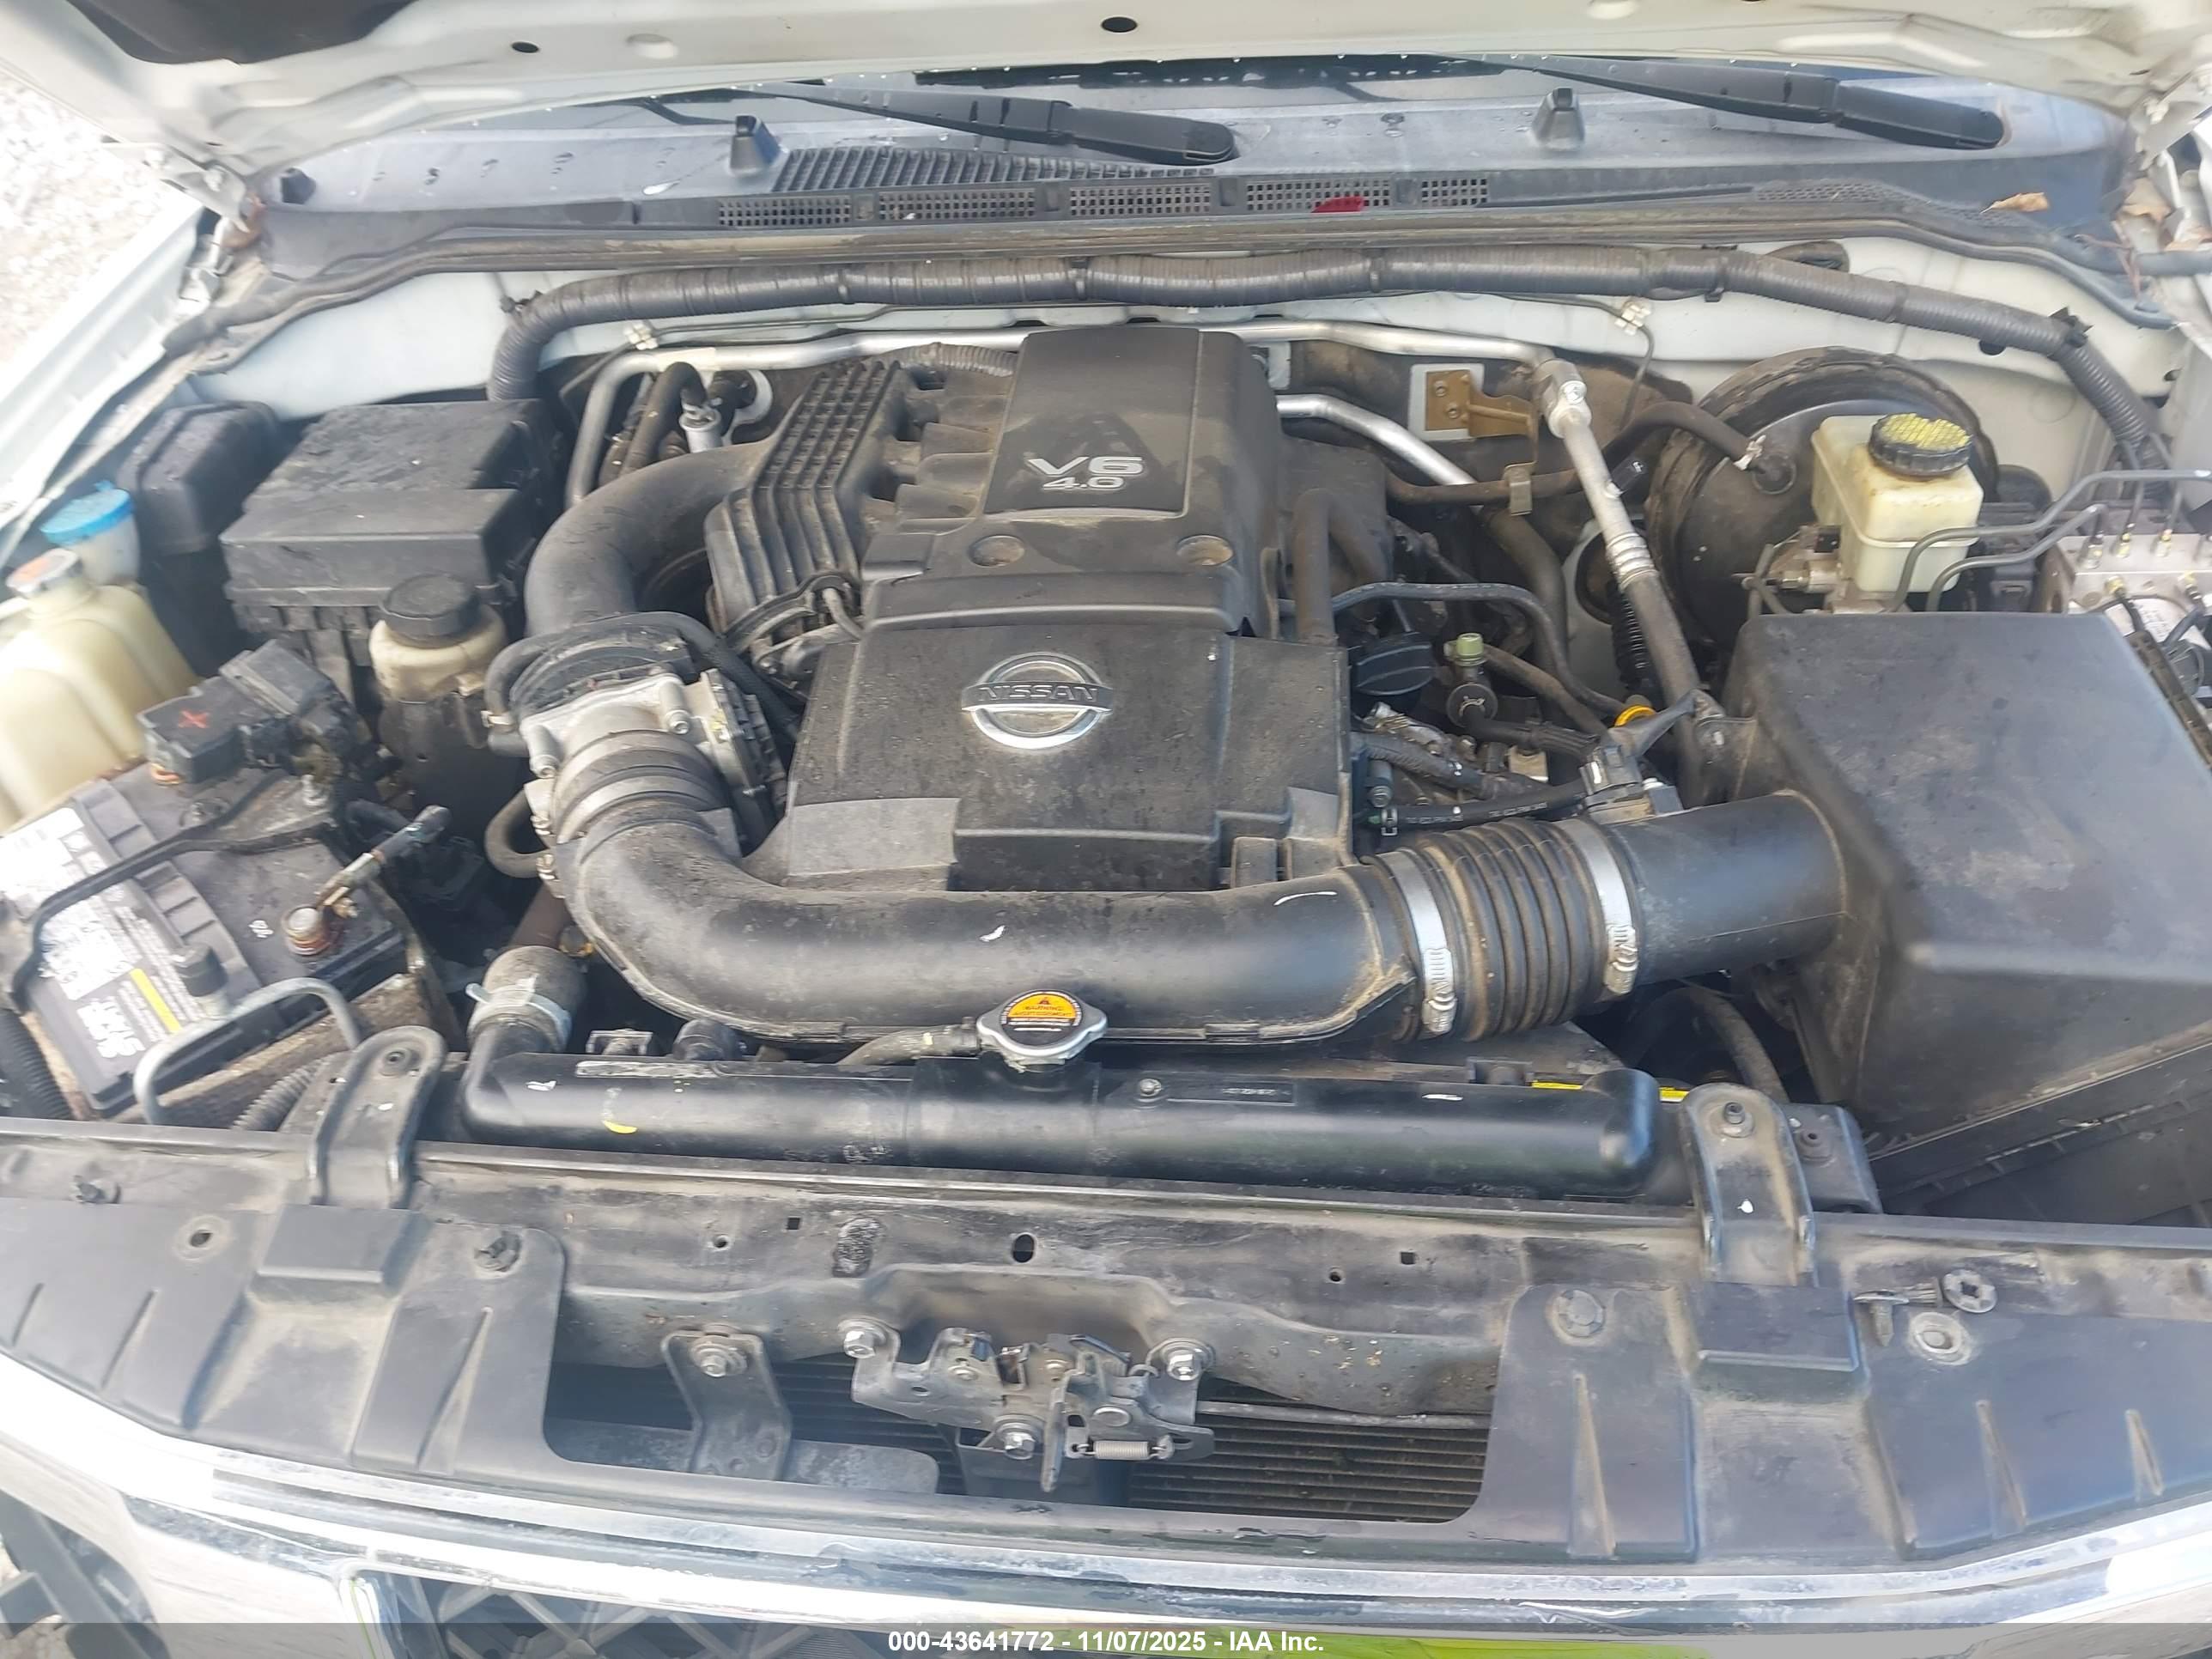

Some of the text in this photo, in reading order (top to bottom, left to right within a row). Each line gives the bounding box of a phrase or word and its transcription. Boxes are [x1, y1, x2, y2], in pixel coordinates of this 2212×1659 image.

[1028, 456, 1144, 475] V6
[1042, 477, 1124, 491] 4.0
[977, 684, 1098, 702] NISSAN
